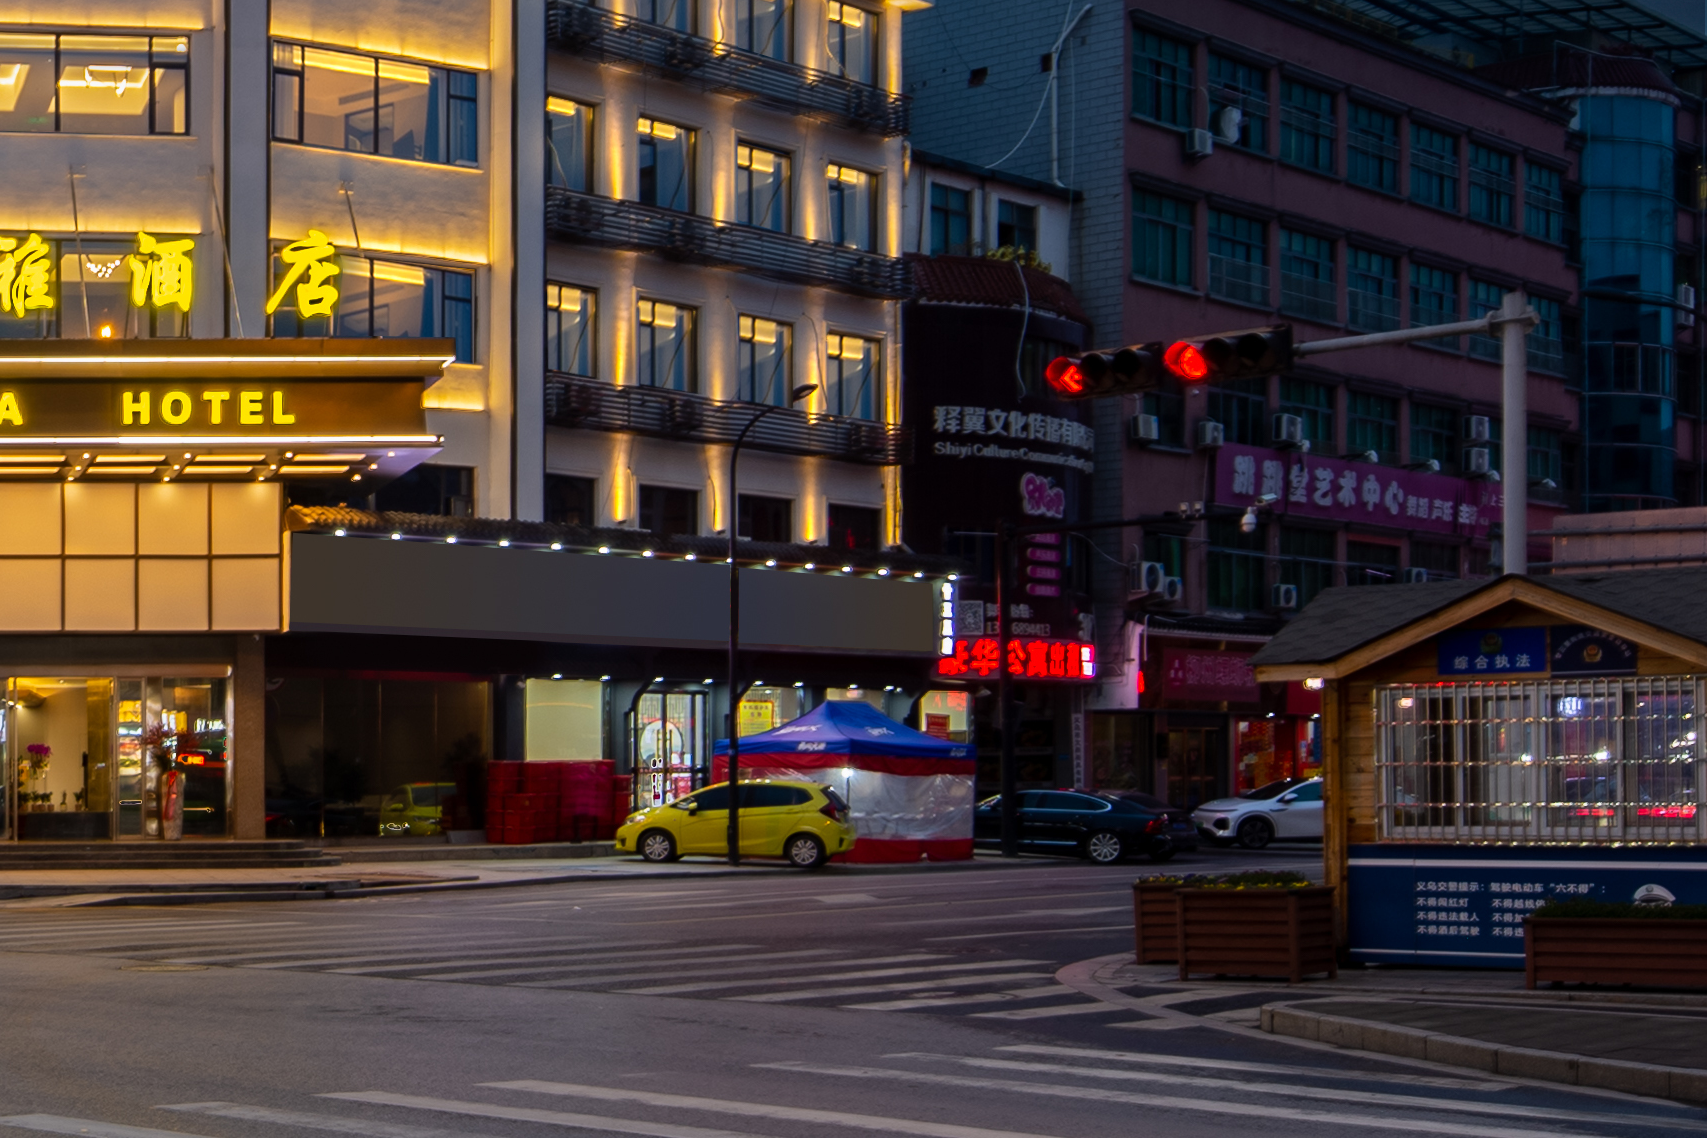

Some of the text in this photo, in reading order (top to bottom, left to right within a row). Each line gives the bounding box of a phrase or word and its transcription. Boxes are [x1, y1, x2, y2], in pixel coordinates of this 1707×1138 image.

[122, 390, 296, 426] HOTEL
[934, 441, 972, 459] Shiyi
[1452, 653, 1532, 670] 综合执法
[1492, 898, 1548, 909] 不得越线停
